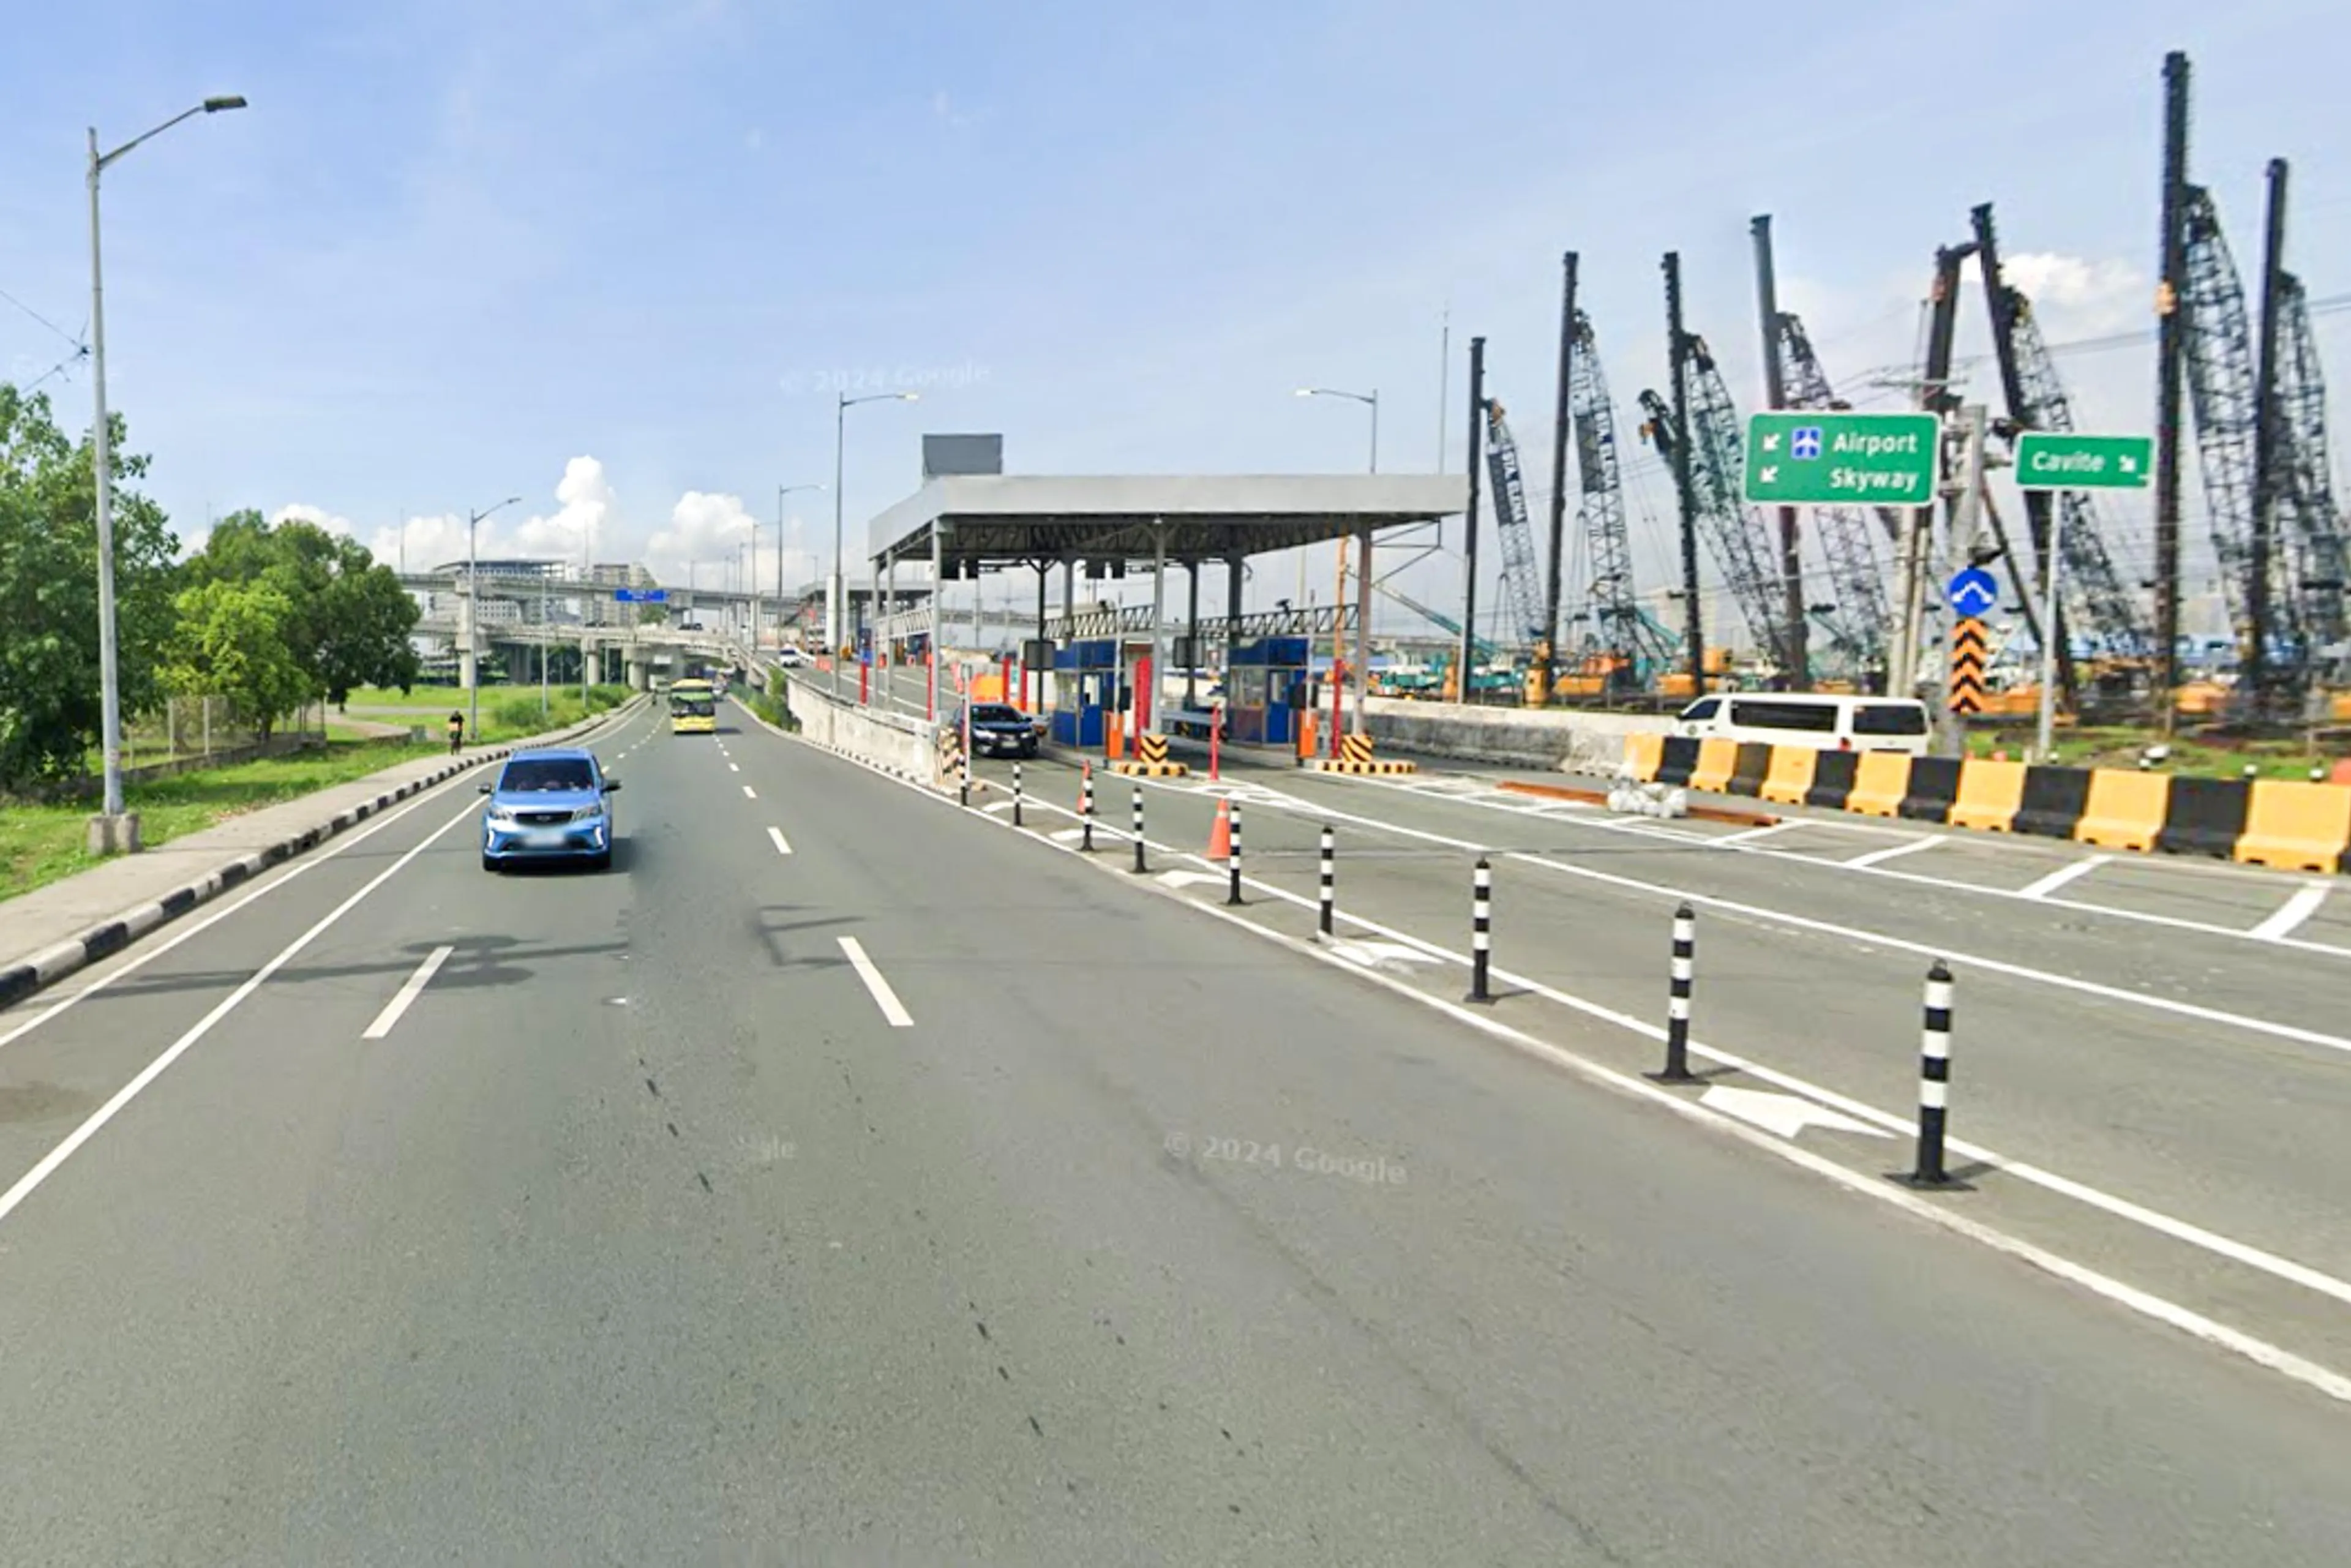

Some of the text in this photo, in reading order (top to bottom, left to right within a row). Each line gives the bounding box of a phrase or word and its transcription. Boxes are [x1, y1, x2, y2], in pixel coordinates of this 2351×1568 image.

[1833, 433, 1918, 457] Airport
[2031, 451, 2106, 473] Cavite
[1829, 467, 1918, 492] Skyway
